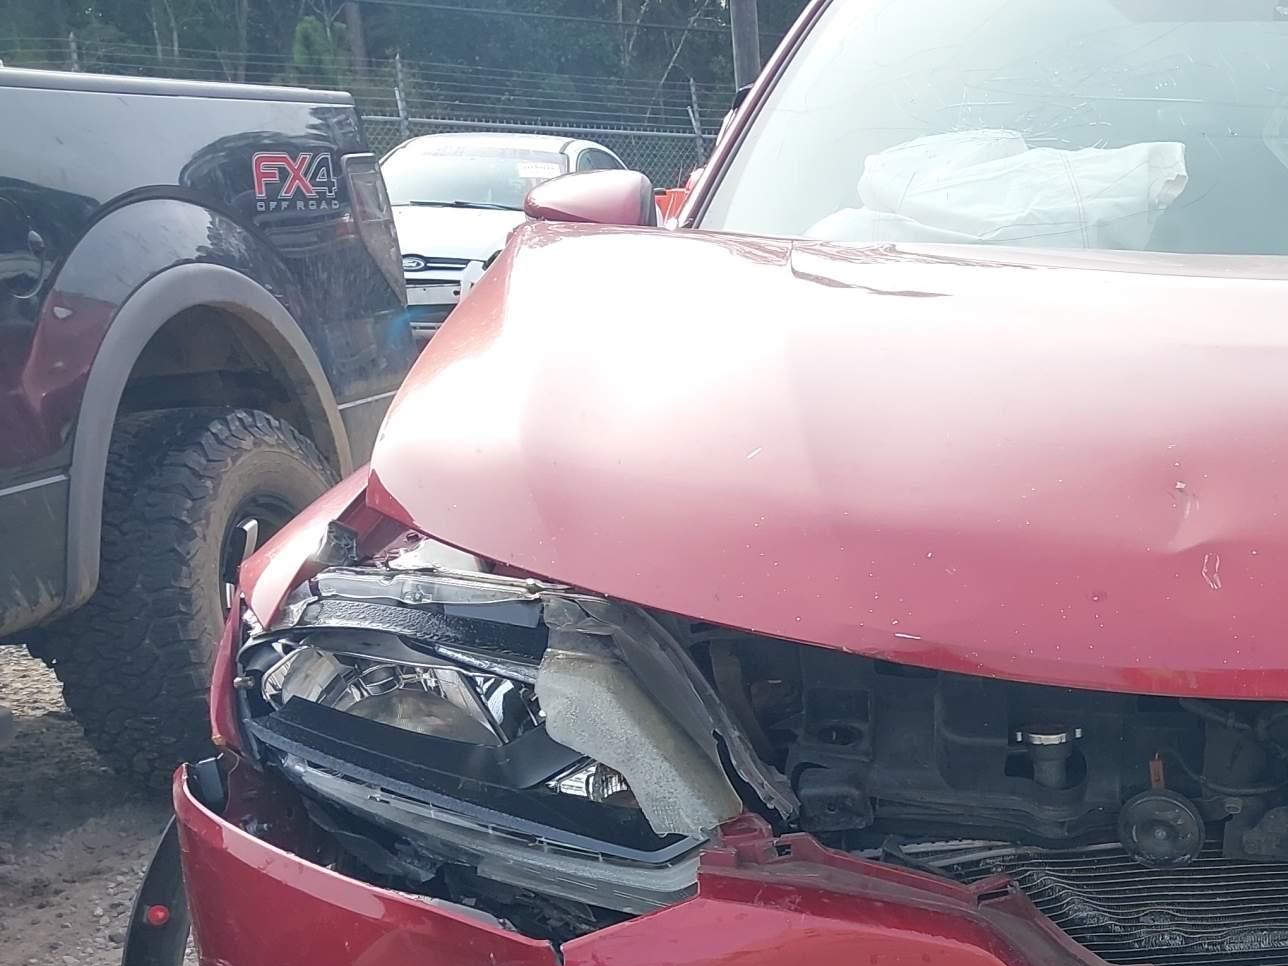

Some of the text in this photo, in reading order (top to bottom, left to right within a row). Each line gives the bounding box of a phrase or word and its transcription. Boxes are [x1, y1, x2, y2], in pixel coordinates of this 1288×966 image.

[252, 151, 338, 199] FX4
[256, 200, 340, 211] OFF ROAD
